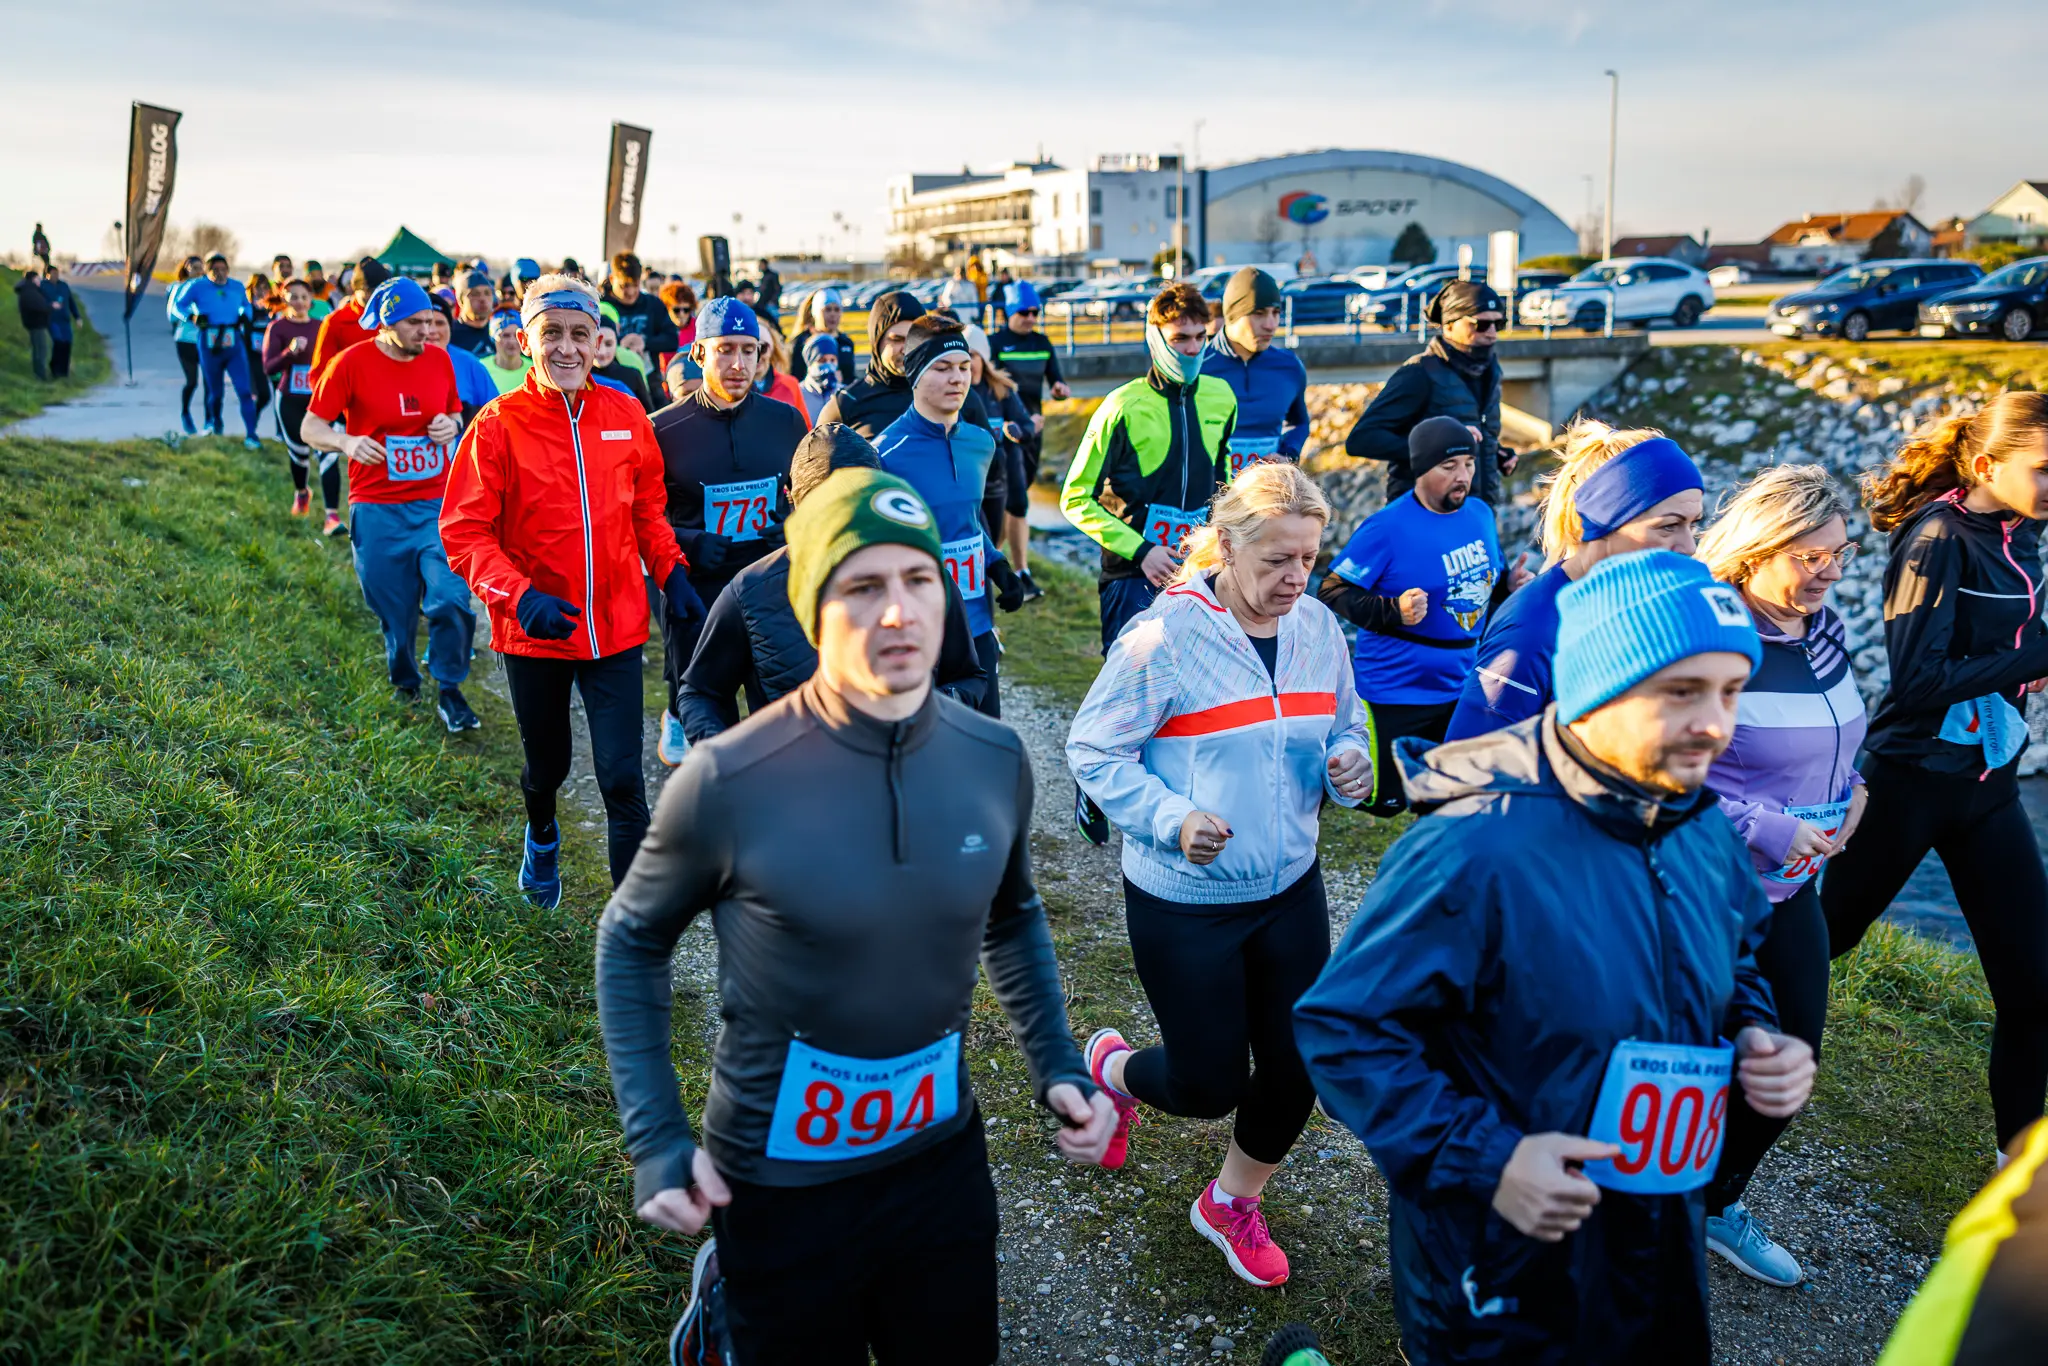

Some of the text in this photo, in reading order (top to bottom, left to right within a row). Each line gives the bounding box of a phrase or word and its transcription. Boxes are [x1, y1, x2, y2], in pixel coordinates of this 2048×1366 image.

[146, 122, 169, 193] PRELOG
[1335, 198, 1418, 217] SPORT
[394, 443, 439, 474] 863
[712, 495, 768, 535] 773
[810, 1059, 850, 1081] KROS
[855, 1072, 889, 1083] LIGA
[1630, 1057, 1668, 1075] KROS
[1670, 1059, 1701, 1076] LIGA
[795, 1073, 935, 1147] 894
[1612, 1082, 1729, 1176] 908
